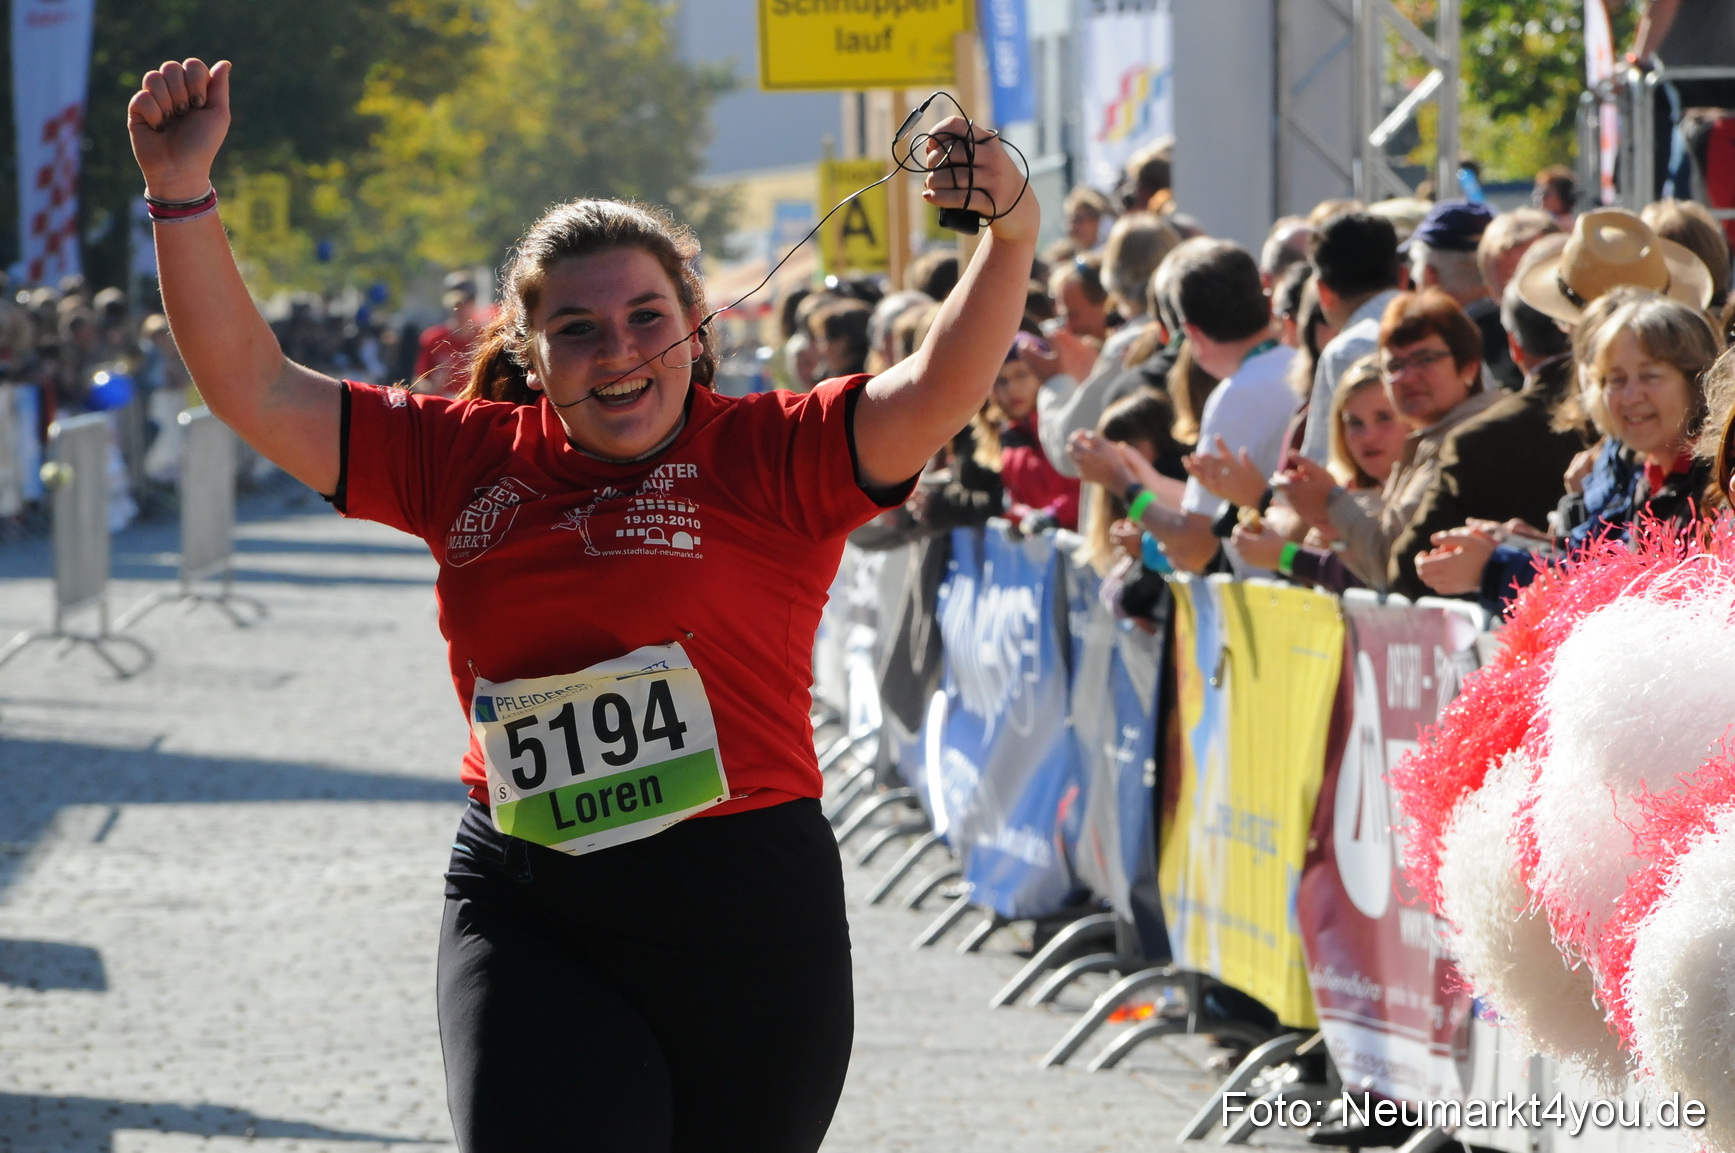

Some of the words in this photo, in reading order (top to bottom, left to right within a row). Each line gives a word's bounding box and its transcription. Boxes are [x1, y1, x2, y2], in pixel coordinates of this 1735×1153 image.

[835, 26, 894, 53] lauf
[841, 196, 877, 247] A
[624, 513, 701, 530] 19.09.2010
[447, 533, 491, 550] MARKT
[601, 547, 704, 560] www.stadtlauf-neumarkt.de
[503, 678, 688, 791] 5194
[499, 786, 507, 800] S
[549, 773, 664, 831] Loren
